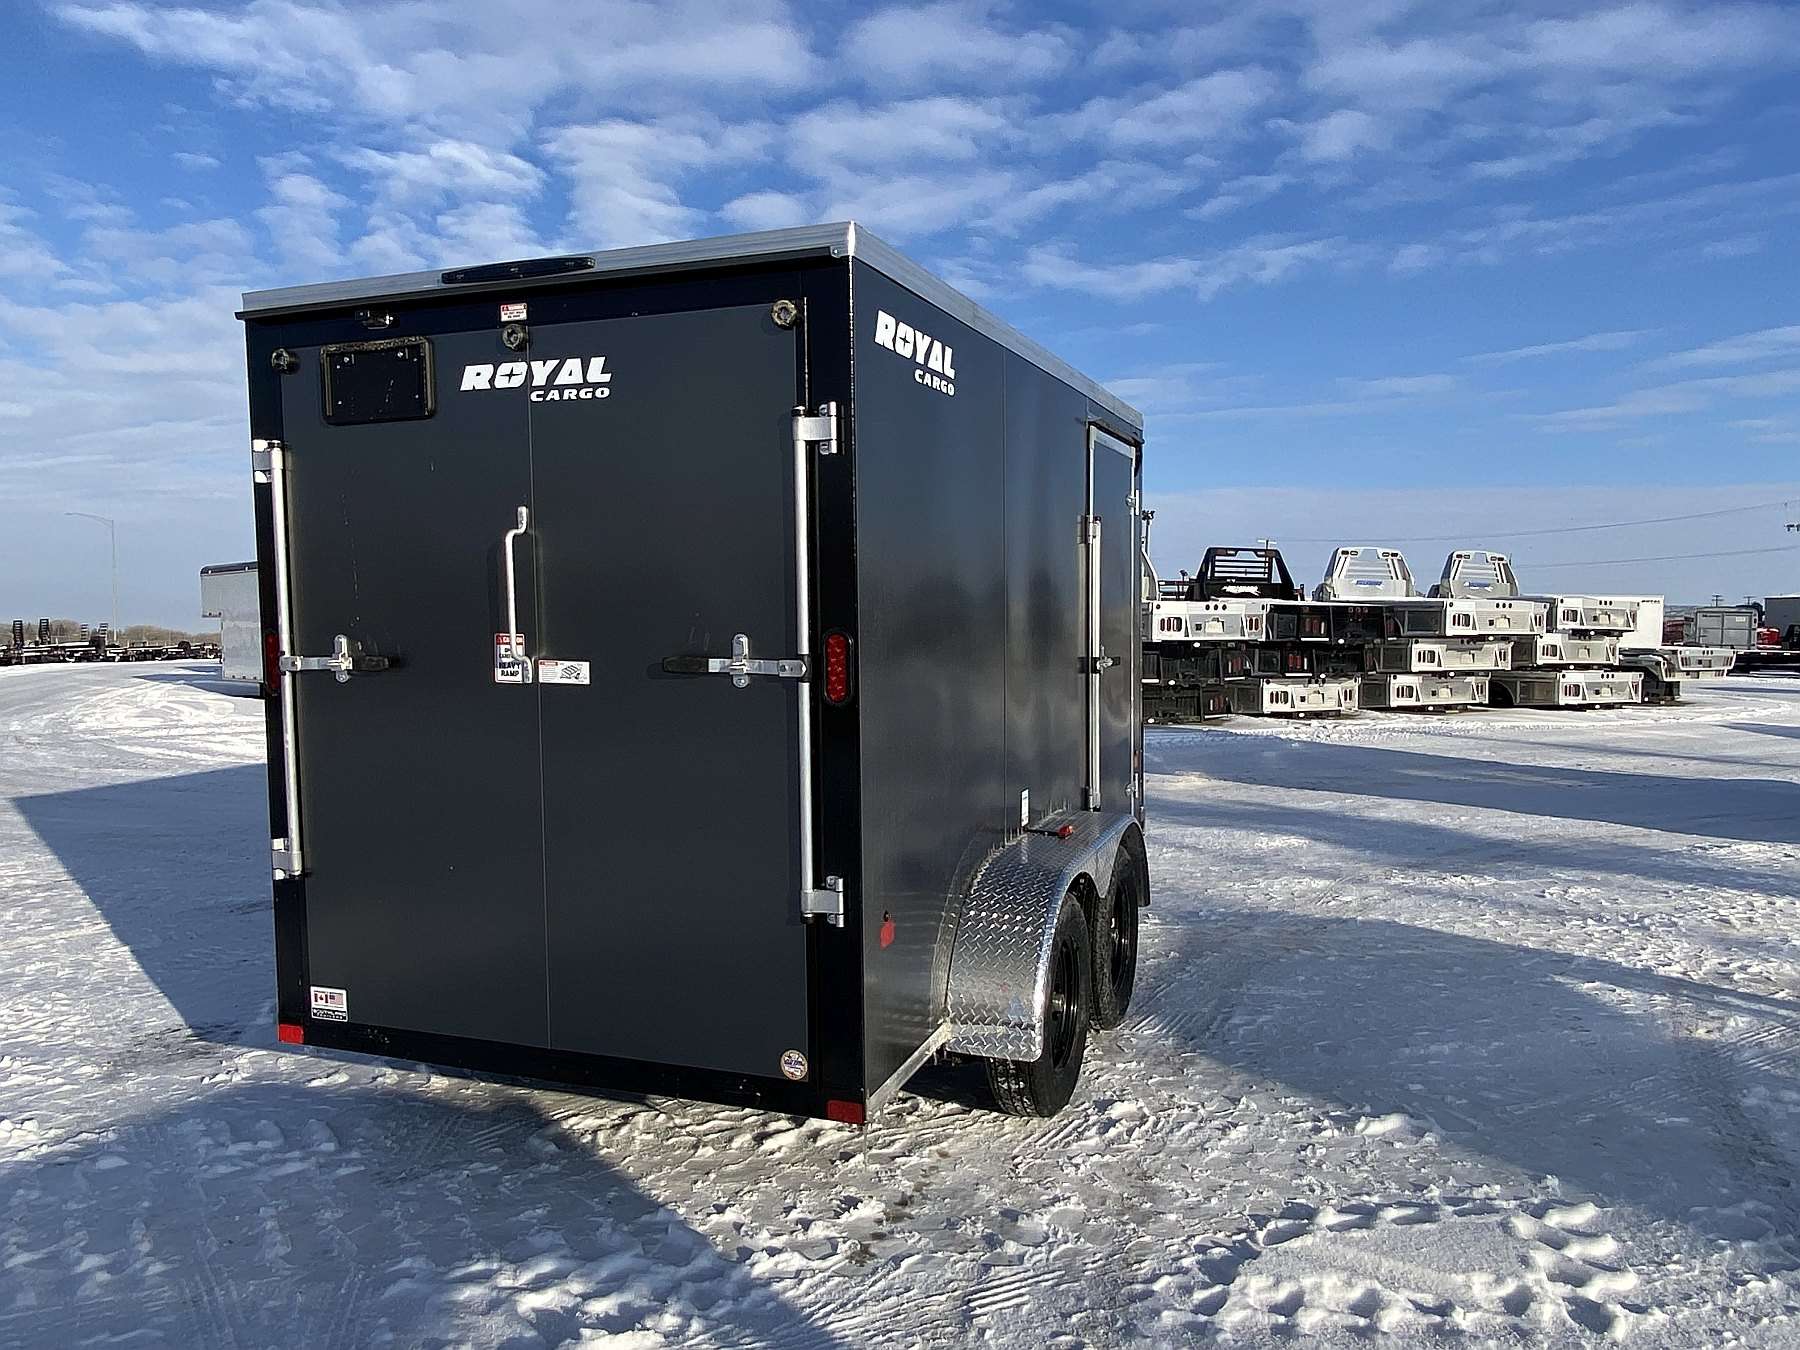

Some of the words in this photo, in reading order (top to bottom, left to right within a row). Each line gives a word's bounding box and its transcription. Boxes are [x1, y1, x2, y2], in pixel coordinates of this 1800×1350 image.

[874, 309, 956, 380] ROYAL
[459, 356, 612, 391] ROYAL
[914, 368, 956, 397] CARGO
[529, 387, 611, 402] CARGO
